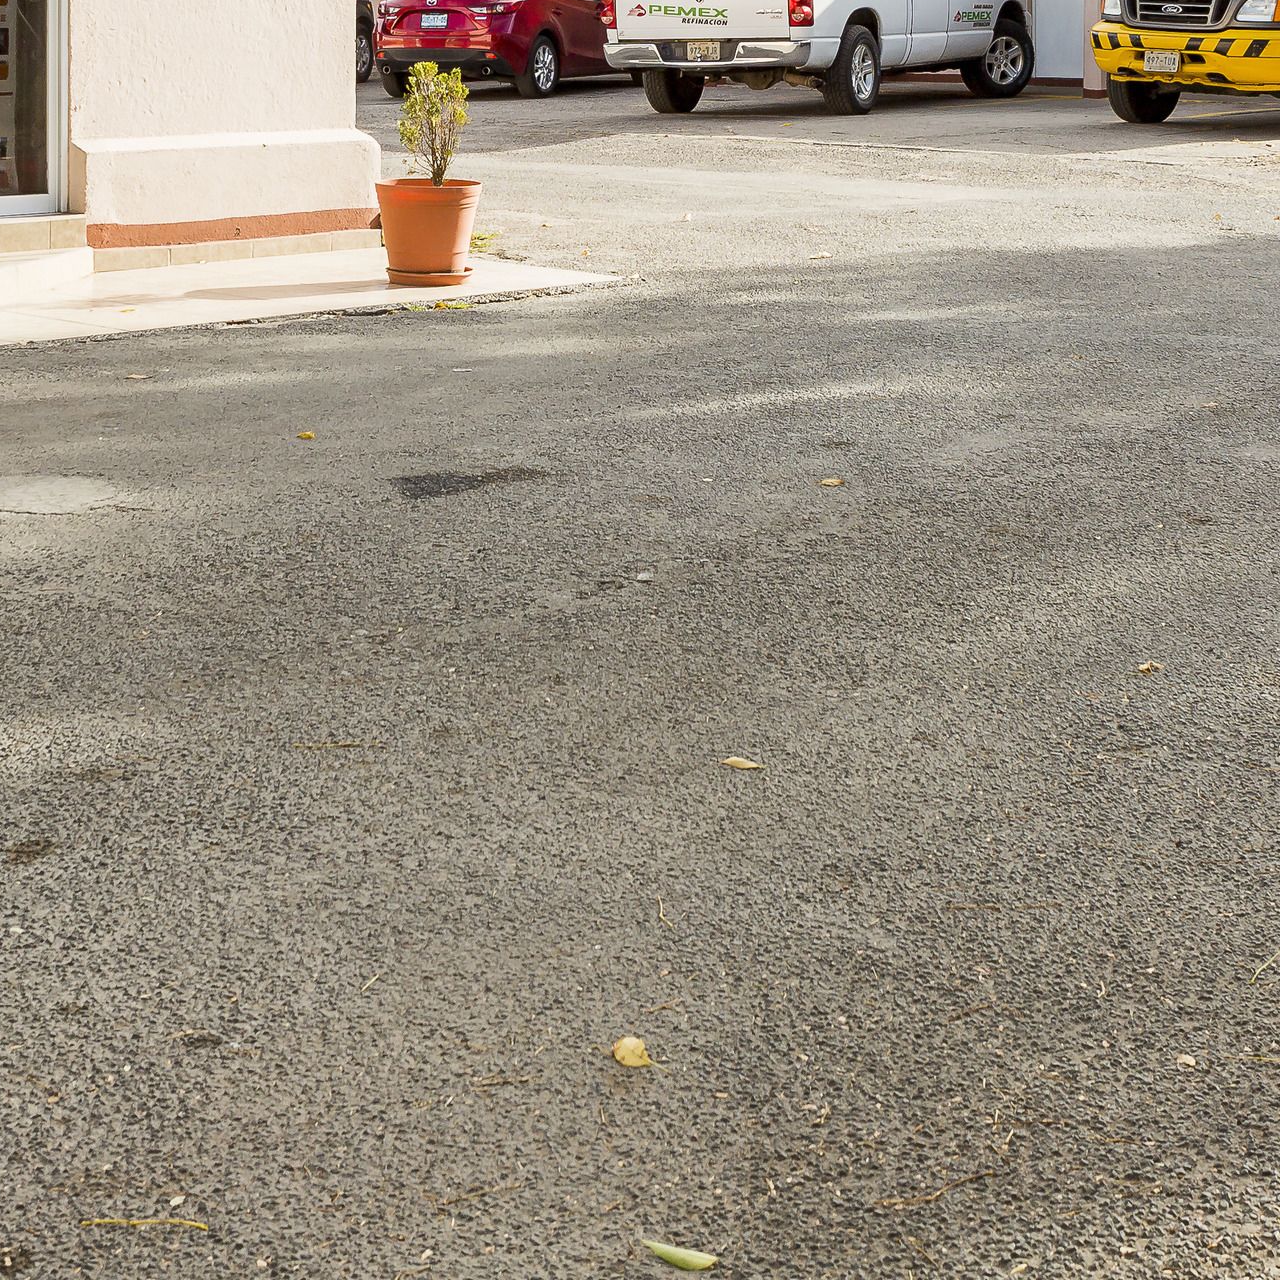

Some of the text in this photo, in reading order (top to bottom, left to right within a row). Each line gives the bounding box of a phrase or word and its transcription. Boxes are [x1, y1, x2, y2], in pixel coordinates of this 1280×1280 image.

[649, 4, 728, 19] PEMEX
[961, 11, 992, 20] PEMEX
[681, 17, 728, 26] REFINACION
